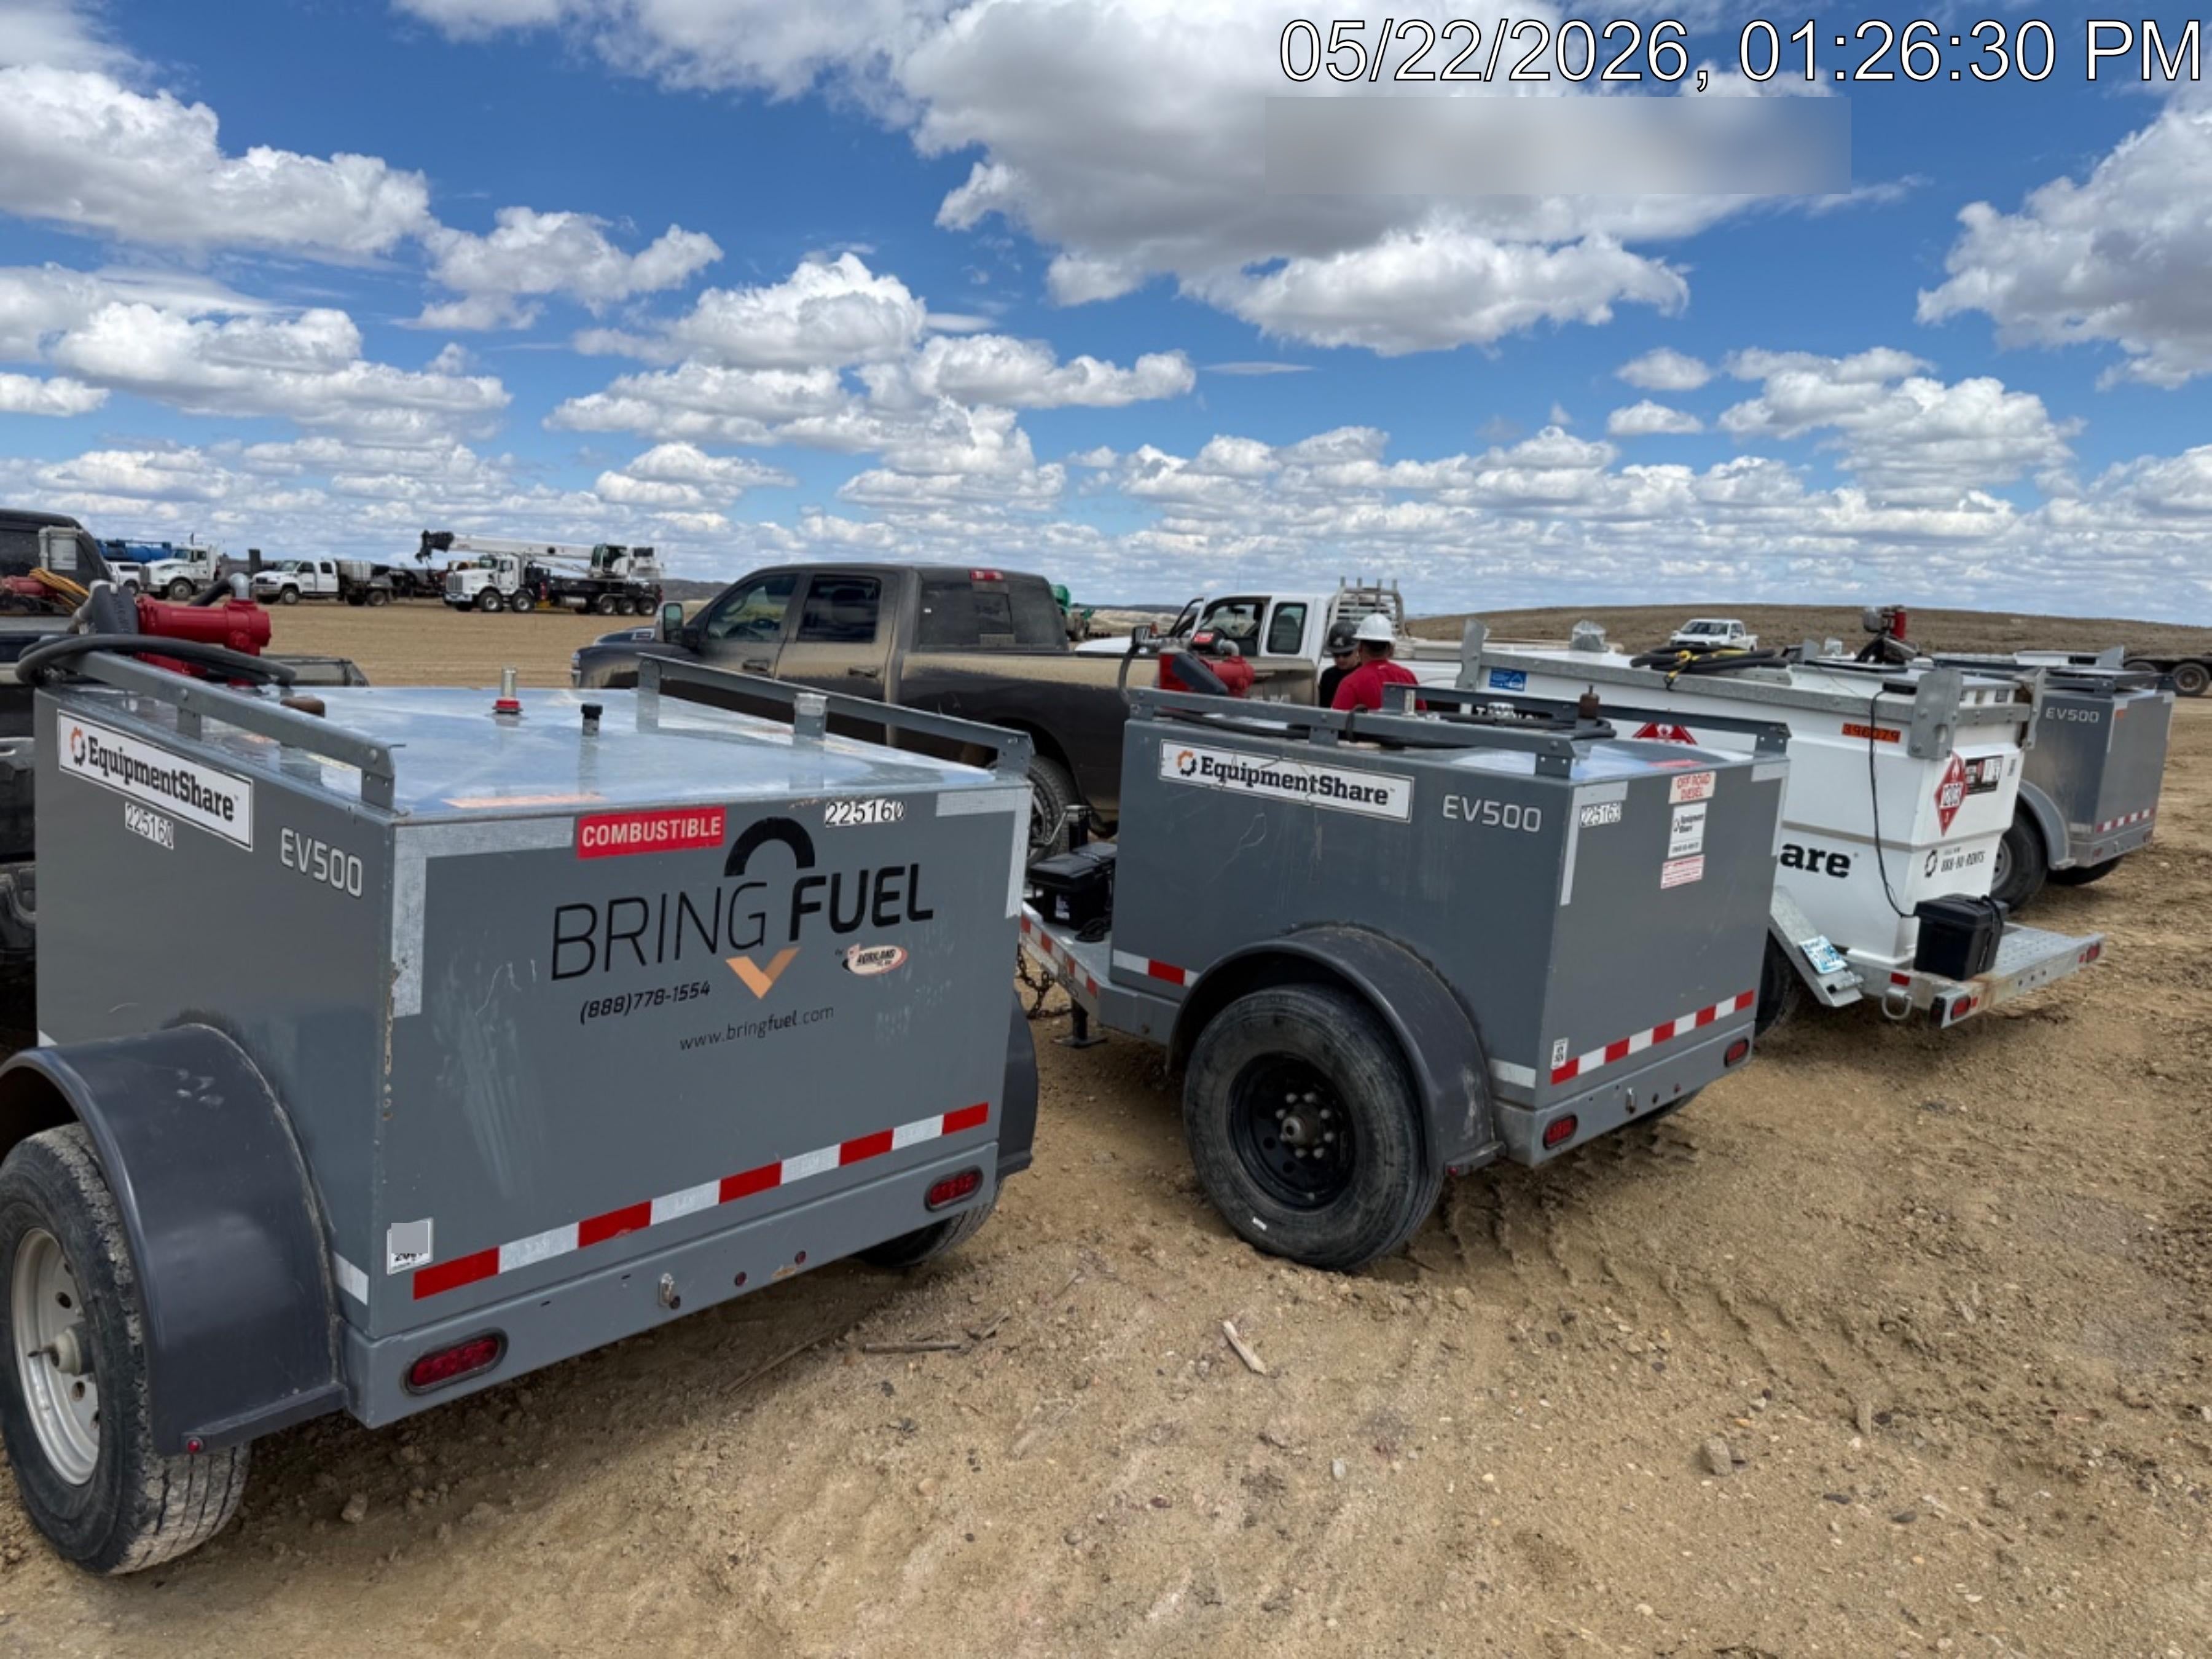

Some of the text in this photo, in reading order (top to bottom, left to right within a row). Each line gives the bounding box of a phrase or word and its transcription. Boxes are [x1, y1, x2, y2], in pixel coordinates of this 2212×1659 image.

[2045, 707, 2100, 723] EV500
[88, 735, 233, 822] EquipmentShare
[1200, 755, 1389, 806] EquipmentShare
[582, 817, 722, 847] COMBUSTIBLE
[1442, 794, 1542, 833] EV500
[281, 826, 363, 898] EV500
[551, 863, 934, 981] BRING FUEL
[580, 981, 711, 1025] (888)778-1554
[680, 1006, 834, 1051] www.bringfuel.com
